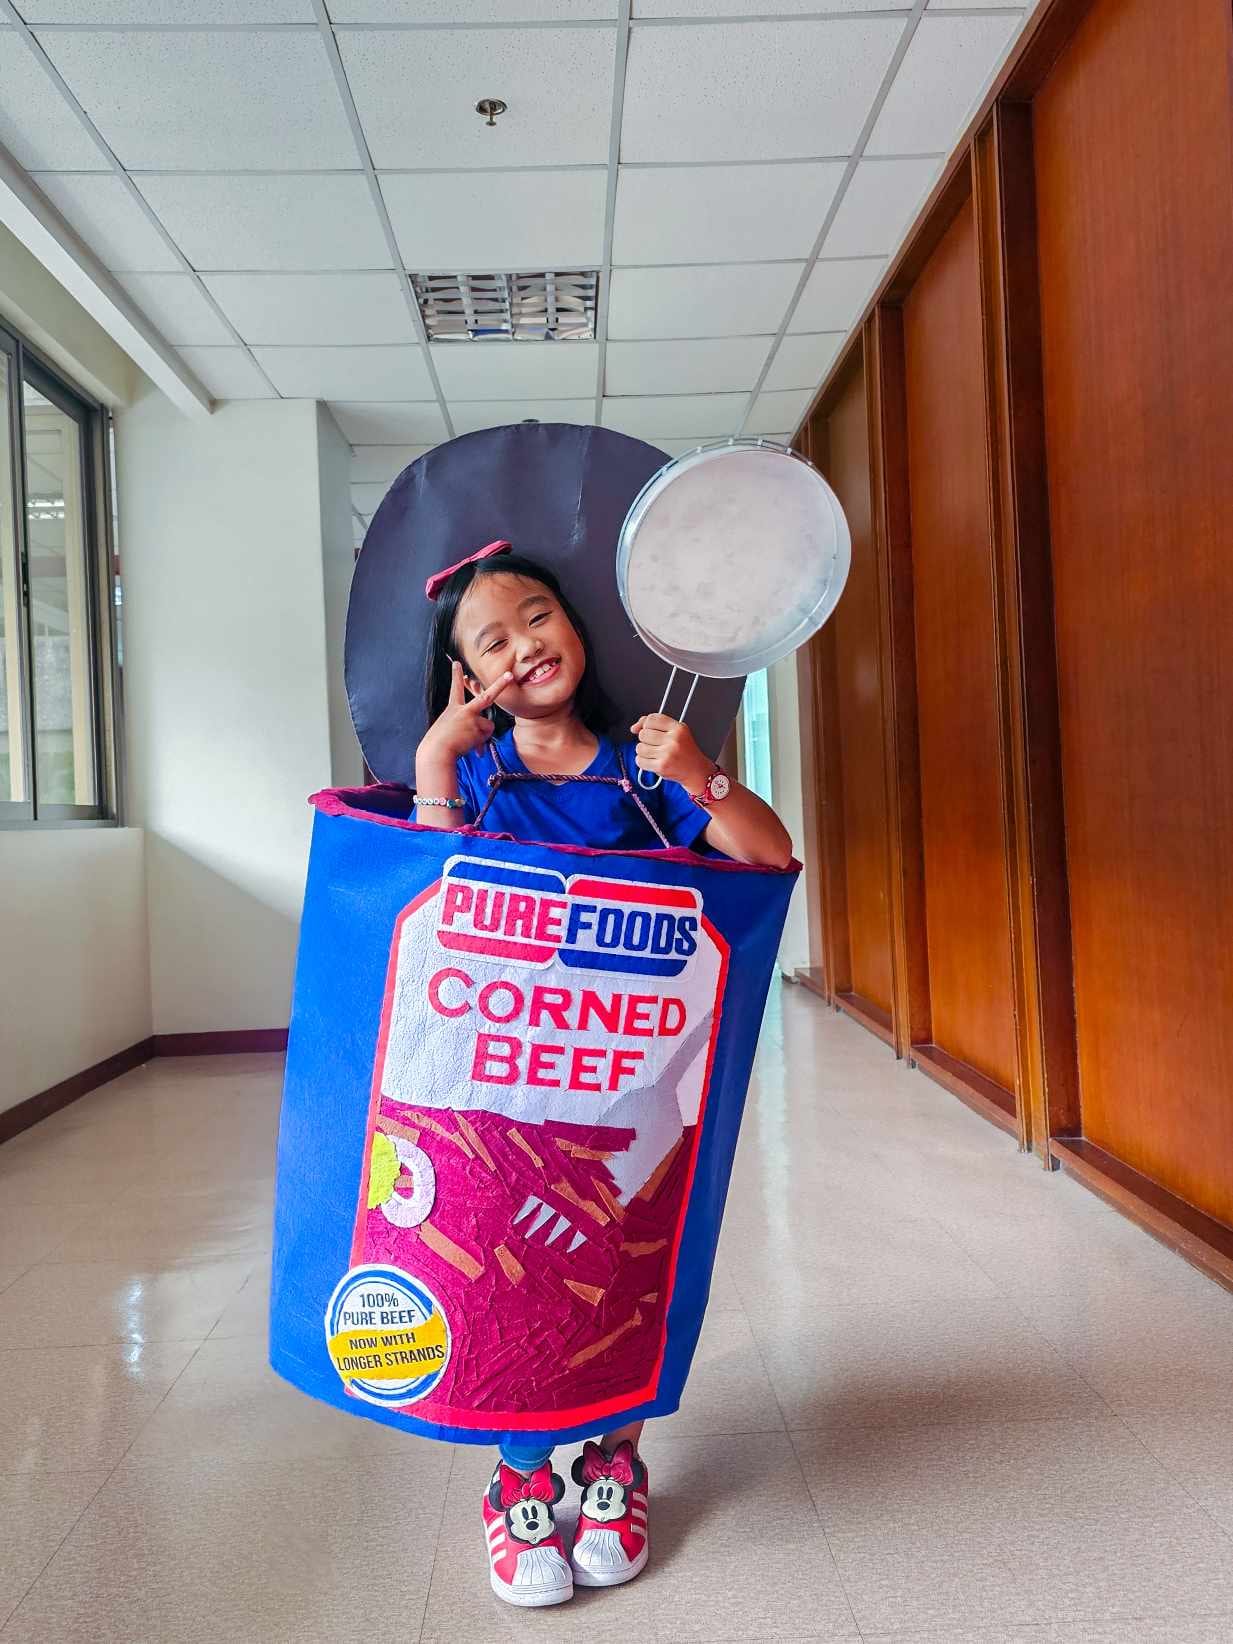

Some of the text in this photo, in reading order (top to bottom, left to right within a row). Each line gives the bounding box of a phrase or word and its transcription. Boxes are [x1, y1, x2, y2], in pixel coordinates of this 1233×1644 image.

[441, 882, 698, 957] PUREFOODS
[428, 967, 687, 1037] CORNED
[471, 1031, 645, 1092] BEEF
[359, 1293, 399, 1308] 100%
[343, 1309, 417, 1325] PURE BEEF
[349, 1332, 416, 1350] NOW WITH
[336, 1345, 445, 1371] LONGER STRANDS
